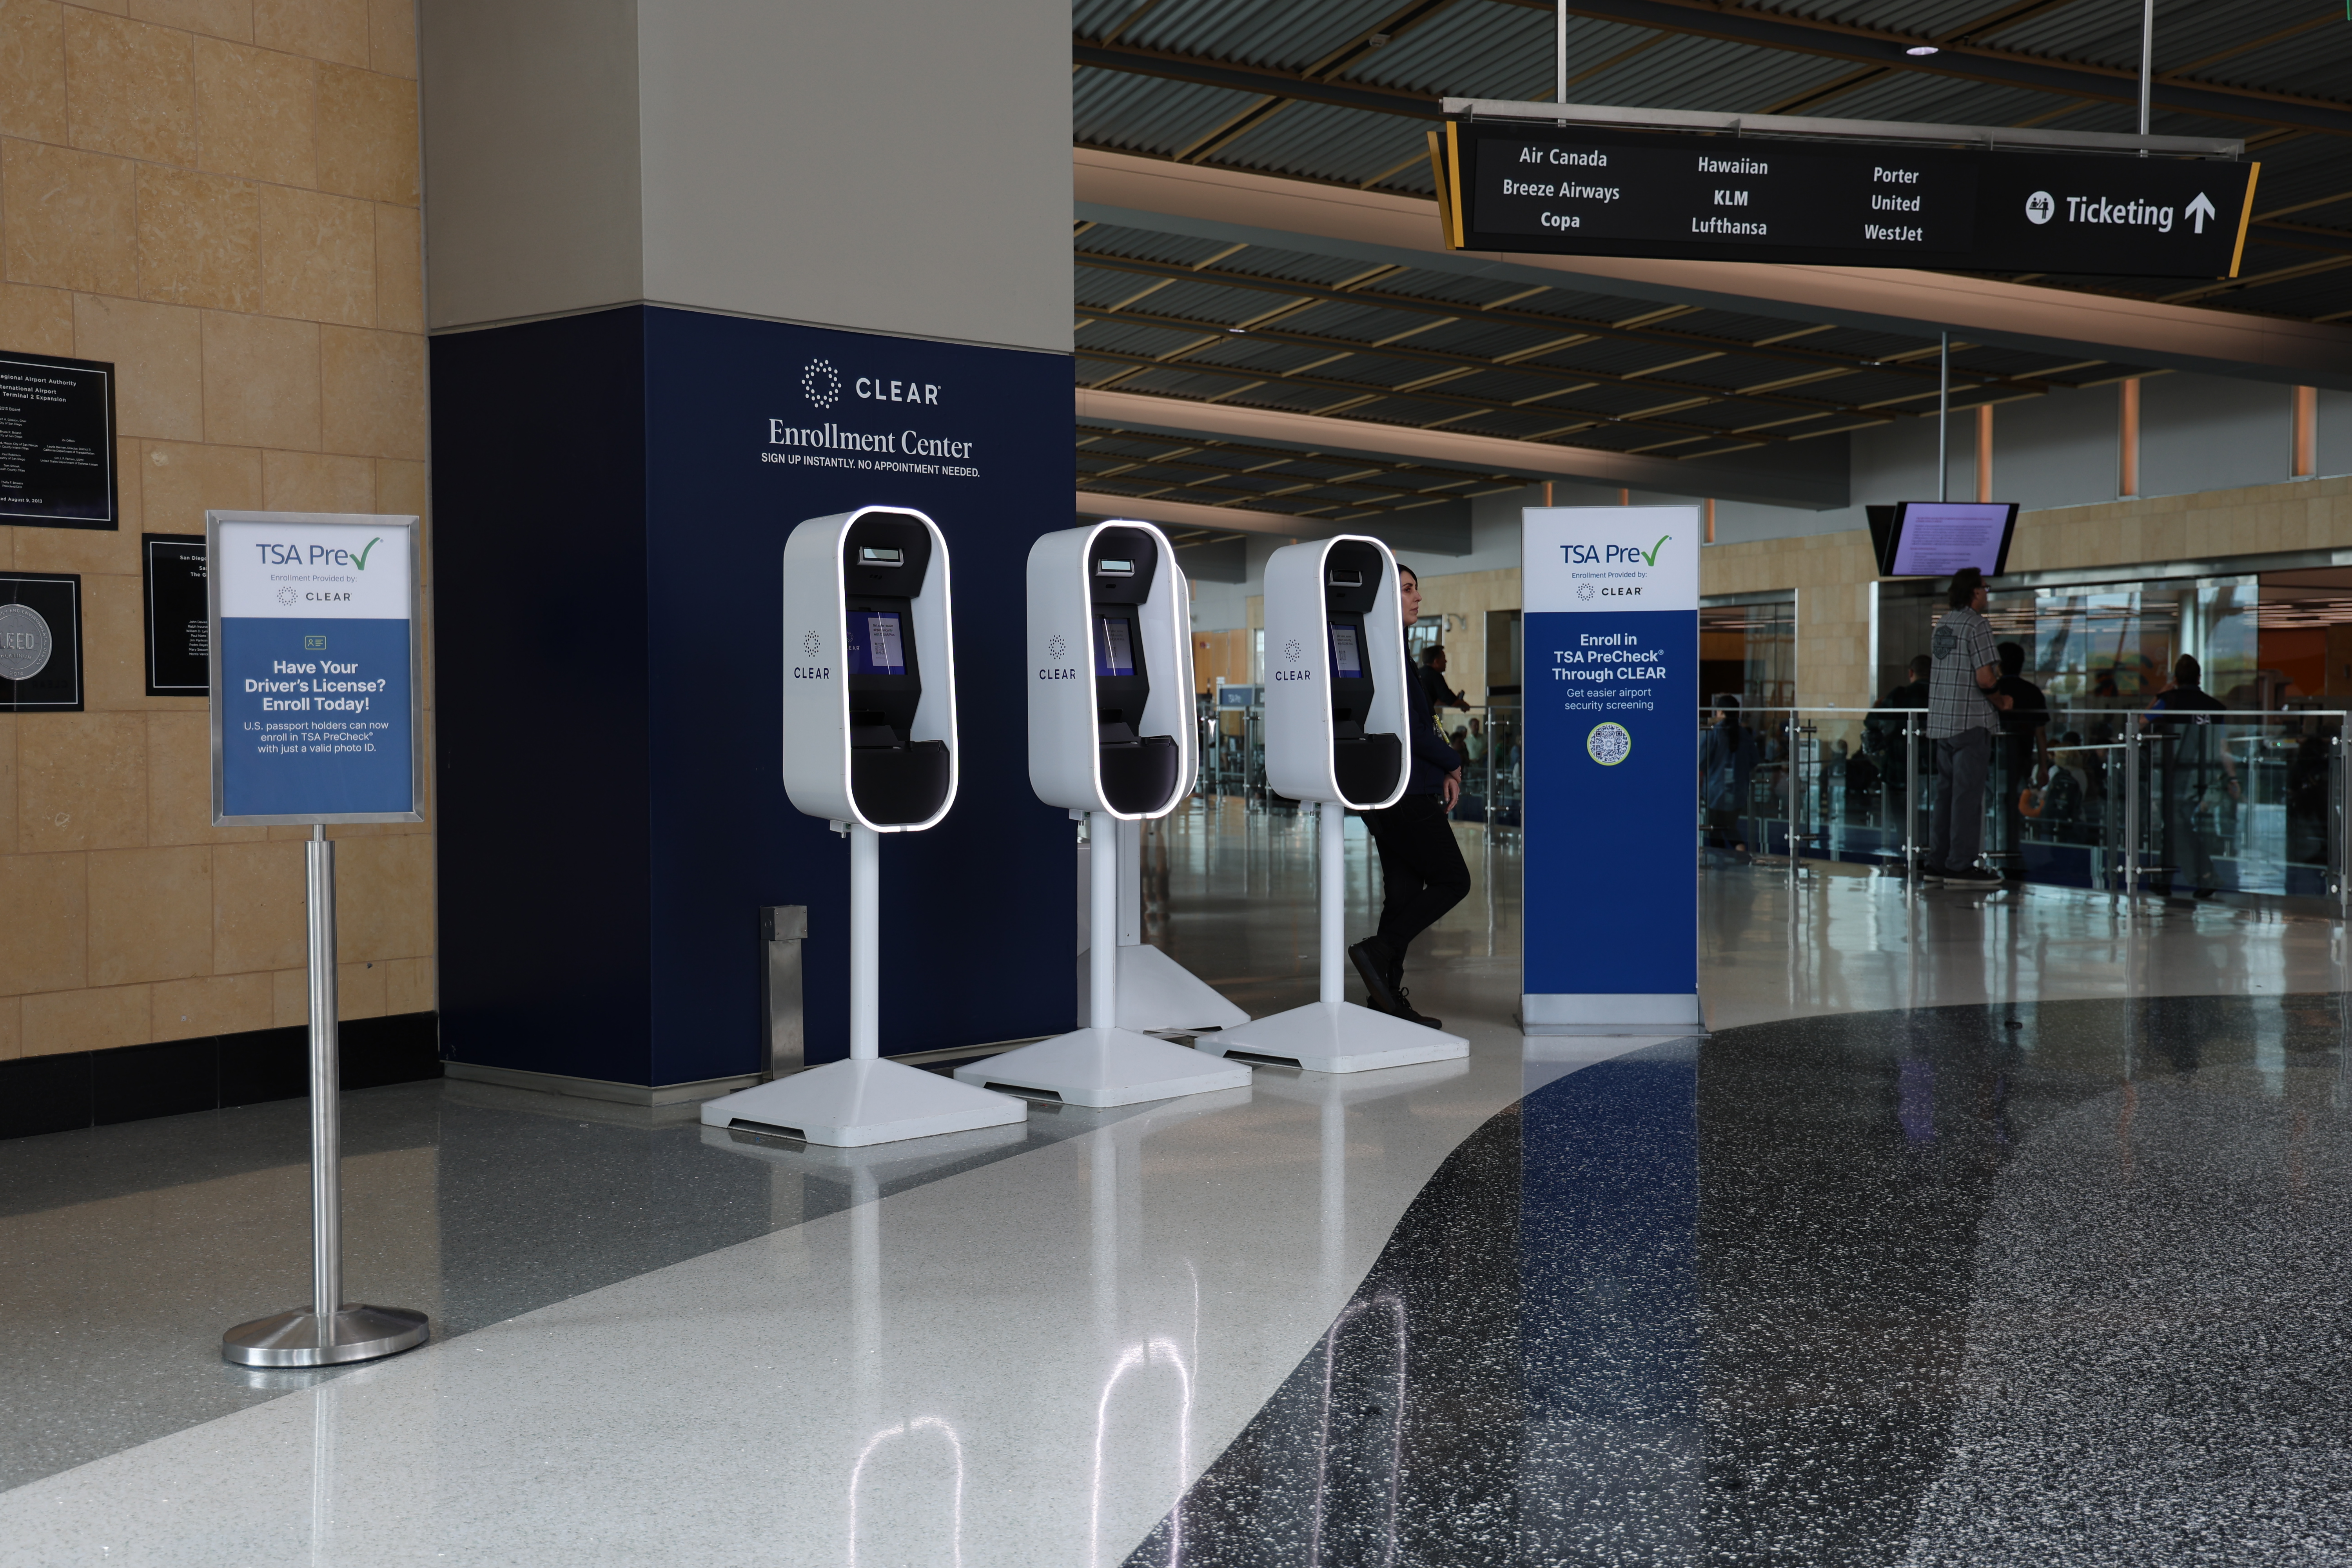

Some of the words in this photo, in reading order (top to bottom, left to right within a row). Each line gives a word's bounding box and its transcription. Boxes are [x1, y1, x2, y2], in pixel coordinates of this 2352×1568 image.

[1519, 147, 1543, 163] Air
[1550, 149, 1606, 166] Canada
[1699, 157, 1768, 174] Hawaiian
[1874, 167, 1919, 183] Porter
[1504, 180, 1554, 196] Breeze
[1559, 182, 1619, 203] Airways
[1714, 190, 1748, 206] KLM
[1872, 195, 1920, 211] United
[1541, 212, 1579, 230] Copa
[2067, 196, 2173, 232] Ticketing
[1692, 217, 1766, 235] Lufthansa
[1865, 224, 1922, 241] WestJet
[769, 419, 896, 453] Enrollment
[902, 430, 972, 458] Center
[762, 453, 785, 463] SIGN
[788, 455, 801, 464] UP
[804, 456, 855, 468] INSTANTLY.
[858, 460, 871, 469] NO
[875, 461, 939, 474] APPOINTMENT
[942, 466, 980, 477] NEEDED.
[256, 544, 303, 564] TSA
[310, 545, 348, 565] Pre
[1560, 545, 1600, 563] TSA
[1606, 545, 1640, 563] Pre
[0, 632, 34, 650] LEED
[22, 610, 48, 645] ENVIRONMENTAL
[36, 648, 47, 666] DESIGN
[1581, 634, 1620, 646] Enroll
[1625, 633, 1637, 645] in
[1554, 651, 1584, 662] TSA
[274, 661, 316, 673] Have
[320, 661, 358, 673] Your
[794, 667, 829, 679] CLEAR
[1040, 669, 1075, 680] CLEAR
[1552, 668, 1613, 682] Through
[1617, 667, 1666, 679] CLEAR
[1276, 671, 1310, 681] CLEAR
[246, 679, 309, 692] Driver's
[314, 679, 385, 692] License?
[1567, 689, 1584, 697] Get
[1587, 688, 1616, 697] easier
[1619, 688, 1651, 698] airport
[263, 698, 310, 710] Enroll
[314, 697, 369, 713] Today!
[1565, 701, 1603, 711] security
[1606, 700, 1653, 711] screening
[267, 722, 309, 731] passport
[281, 744, 298, 754] just
[335, 744, 361, 753] photo
